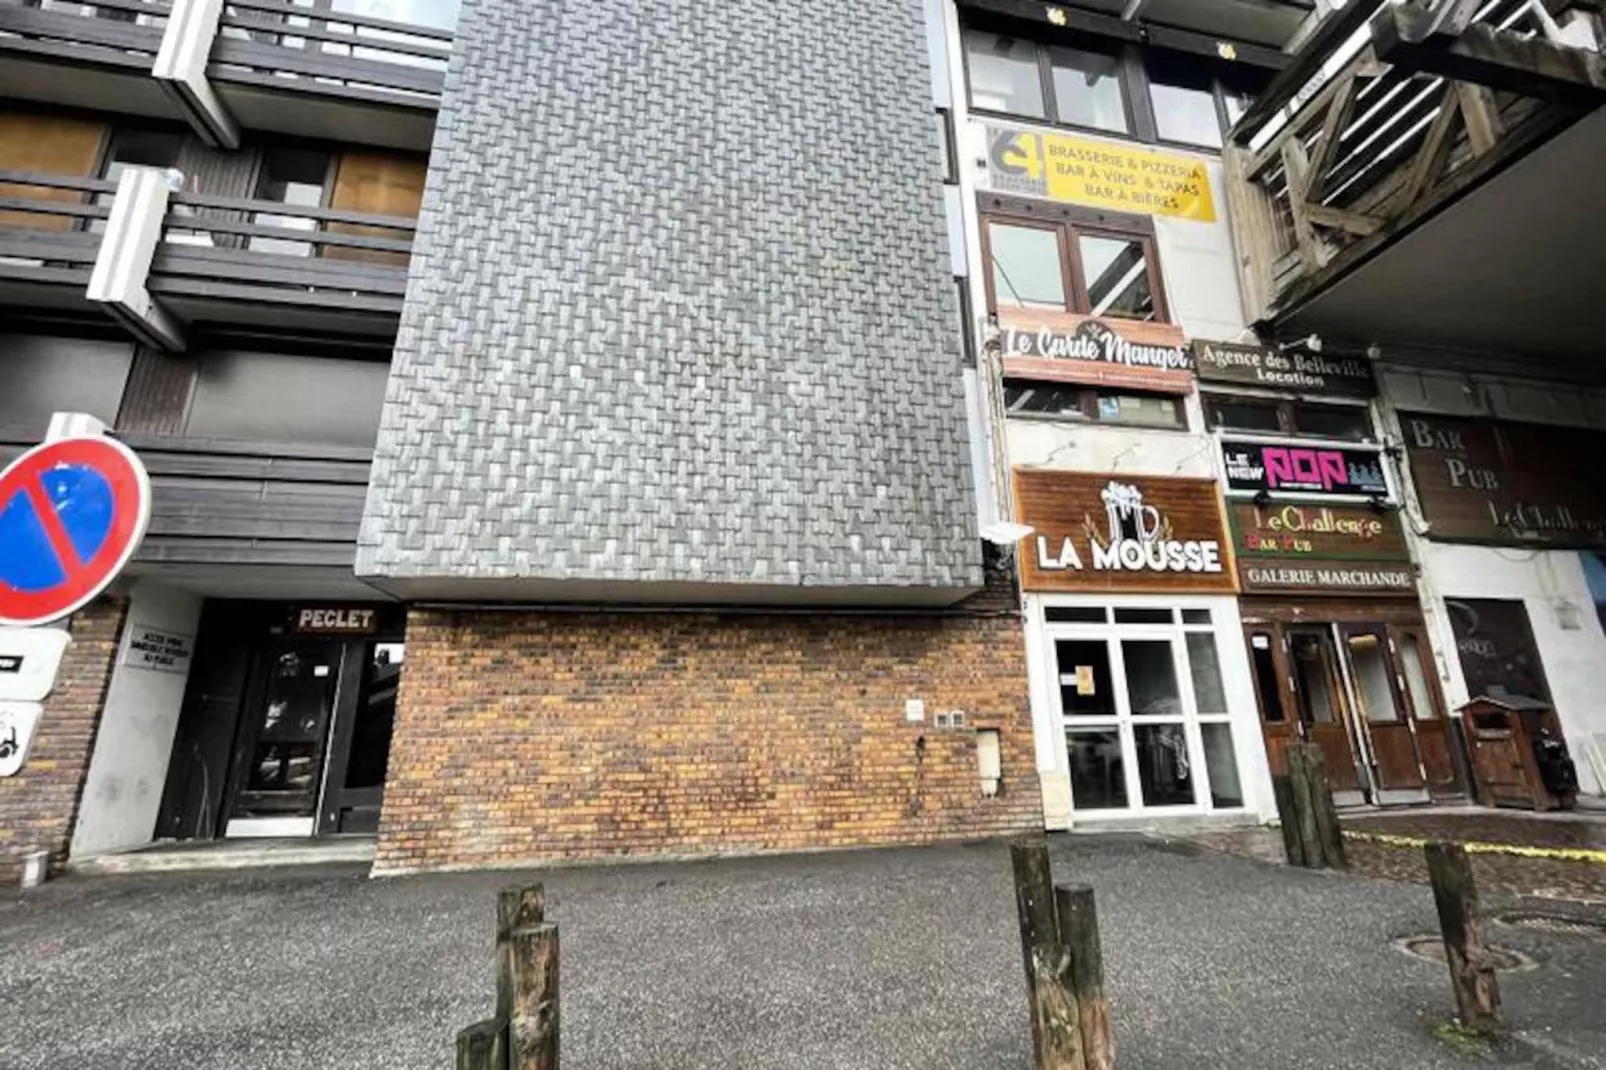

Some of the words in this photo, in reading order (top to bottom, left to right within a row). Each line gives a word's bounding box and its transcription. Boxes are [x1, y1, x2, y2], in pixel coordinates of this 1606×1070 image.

[1048, 144, 1125, 169] BRASSERIE
[1127, 157, 1138, 170] &
[1141, 159, 1201, 180] PIZZERIA
[1056, 162, 1085, 177] BAR
[1103, 169, 1138, 186] VINS
[1157, 178, 1200, 196] TAPAS
[1085, 184, 1114, 199] BAR
[1005, 324, 1032, 357] Le
[1100, 331, 1189, 371] Manger
[1202, 344, 1262, 368] Agence
[1265, 351, 1291, 369] des
[1256, 367, 1325, 387] Location
[1225, 453, 1249, 466] LE
[1228, 466, 1264, 481] NEW
[1036, 534, 1084, 571] LA
[1090, 537, 1222, 573] MOUSSE
[1249, 566, 1316, 584] GALERIE
[1316, 569, 1411, 587] MARCHANDE
